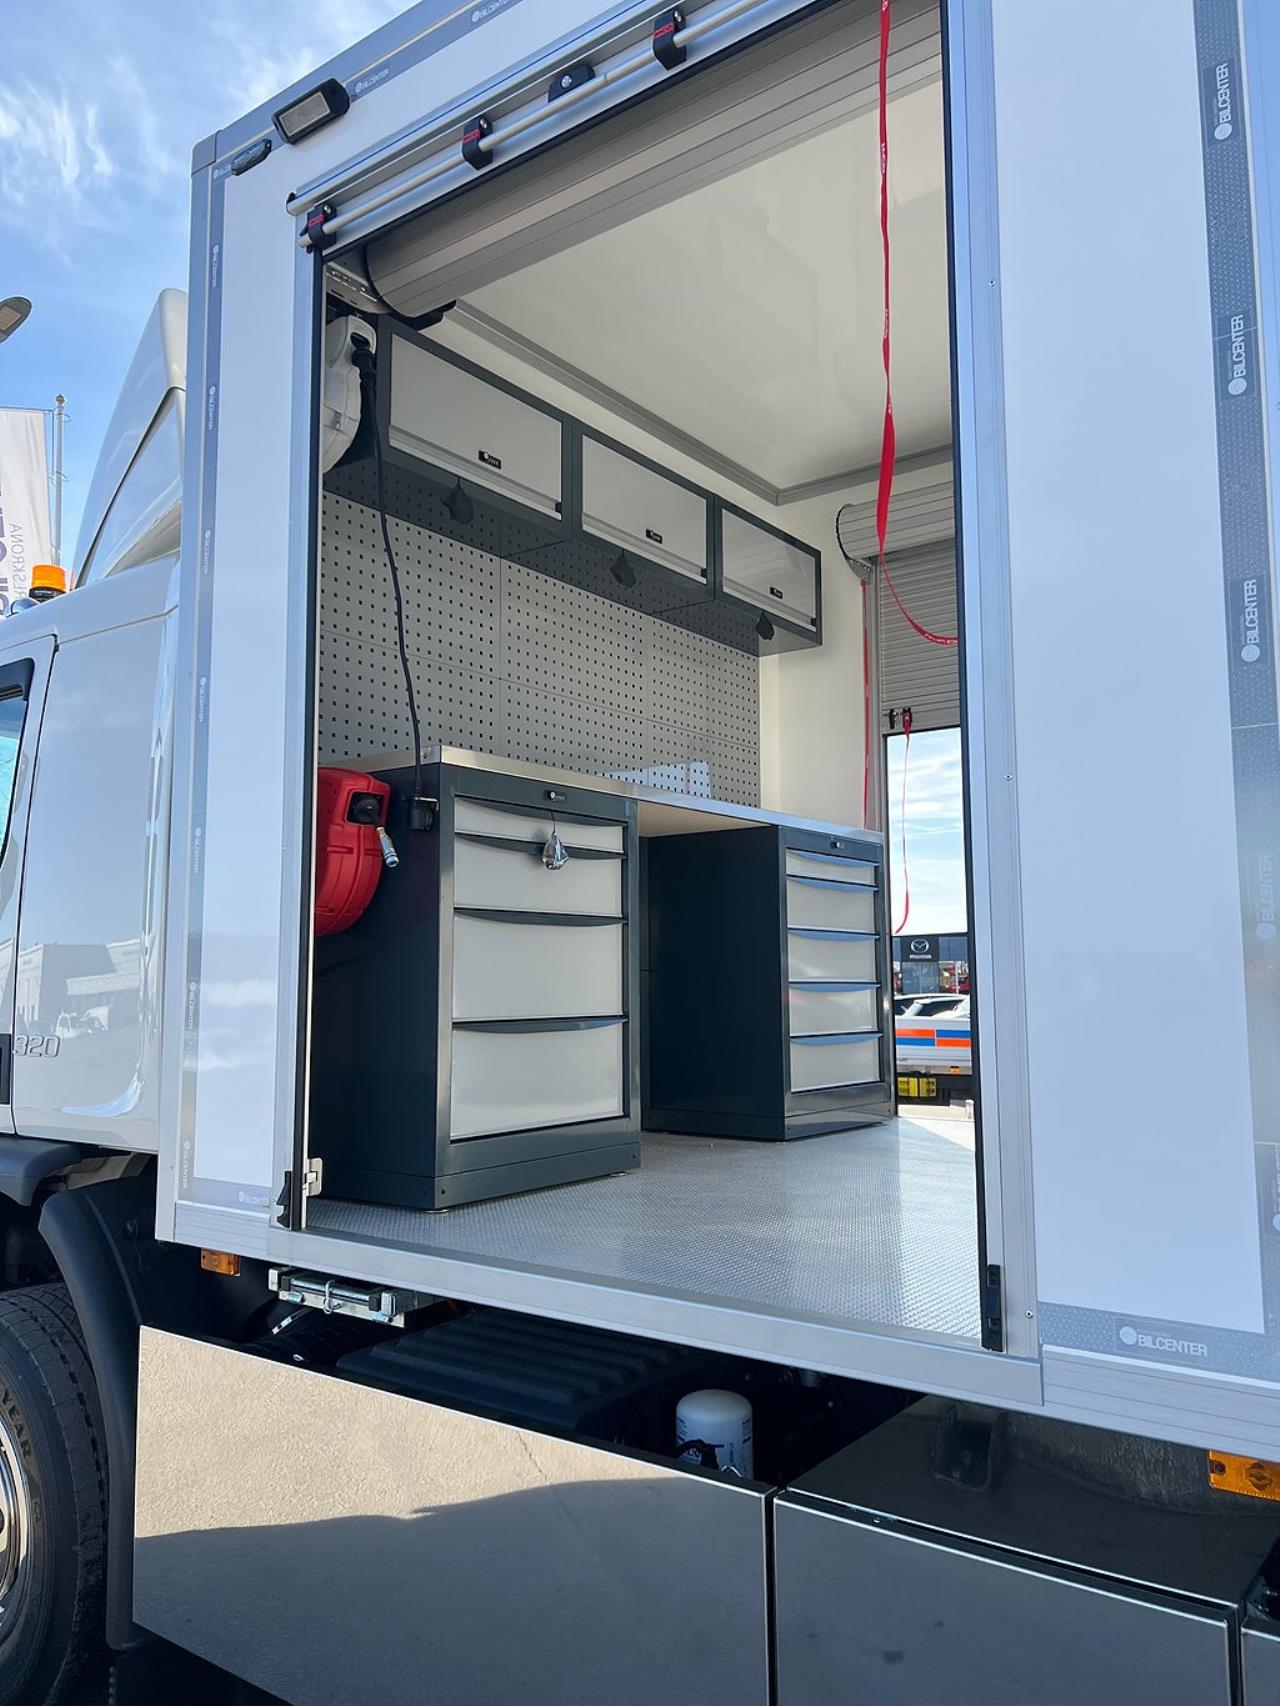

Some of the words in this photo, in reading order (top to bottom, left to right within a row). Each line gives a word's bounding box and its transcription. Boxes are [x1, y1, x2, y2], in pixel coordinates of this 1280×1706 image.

[1216, 62, 1232, 123] BILCENTER
[1231, 314, 1246, 378] BILCENTER
[1243, 579, 1259, 644] BILCENTER
[15, 1035, 60, 1057] 320
[1138, 1333, 1208, 1357] BILCENTER
